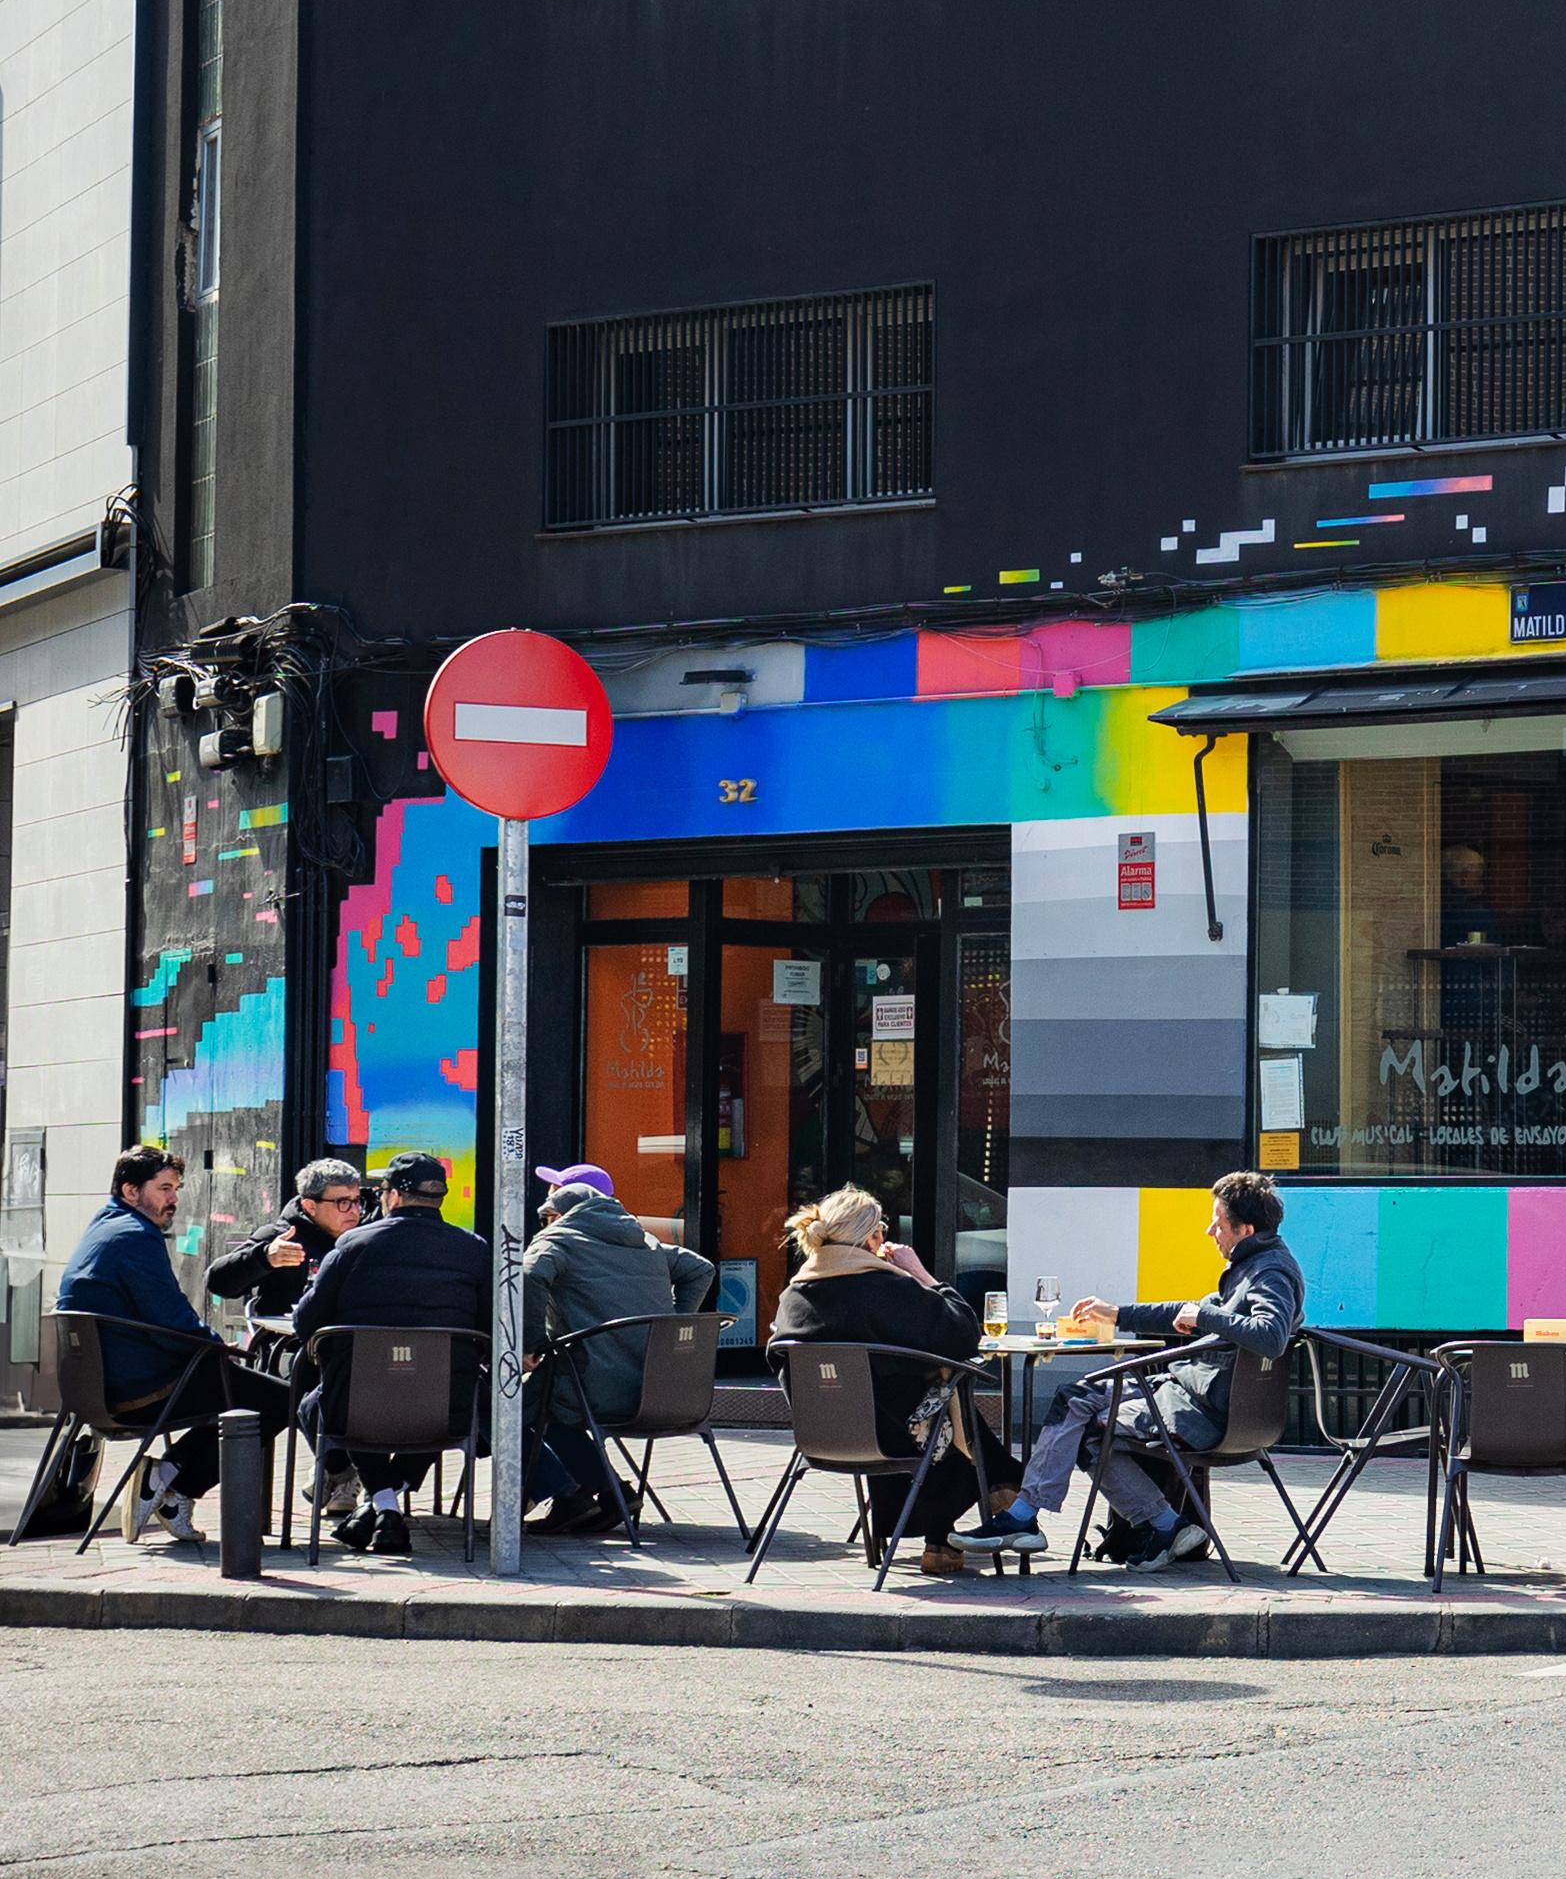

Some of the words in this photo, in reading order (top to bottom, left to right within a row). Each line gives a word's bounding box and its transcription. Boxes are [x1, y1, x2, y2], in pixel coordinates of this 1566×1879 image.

[719, 779, 759, 802] 32
[1121, 865, 1152, 876] Alarma
[1429, 1125, 1484, 1146] LOCALES
[1490, 1126, 1510, 1145] DE
